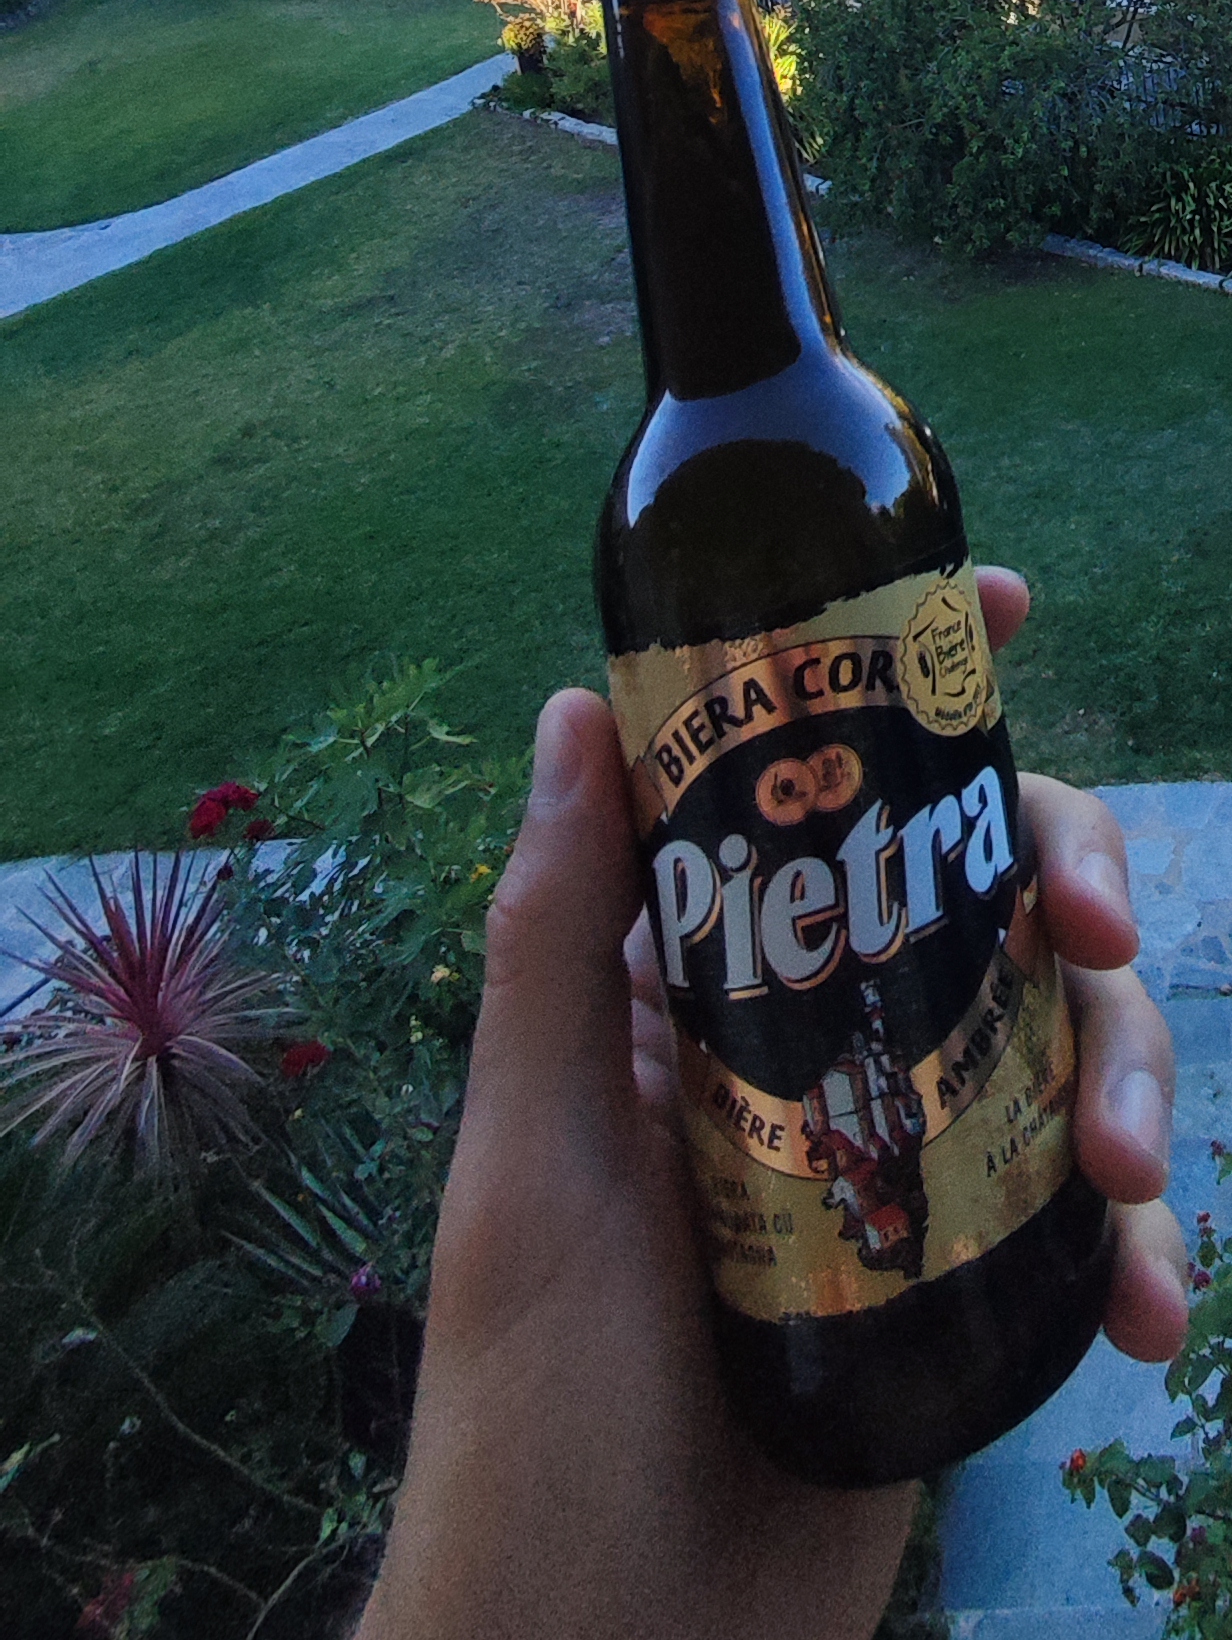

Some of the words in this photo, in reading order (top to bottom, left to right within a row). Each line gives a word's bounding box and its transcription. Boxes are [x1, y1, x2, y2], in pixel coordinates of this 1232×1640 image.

[654, 677, 778, 789] BIERA
[792, 649, 900, 701] COR
[652, 765, 1018, 1000] Pietra
[712, 1083, 786, 1152] BIÈRE
[1002, 1137, 1020, 1165] LA
